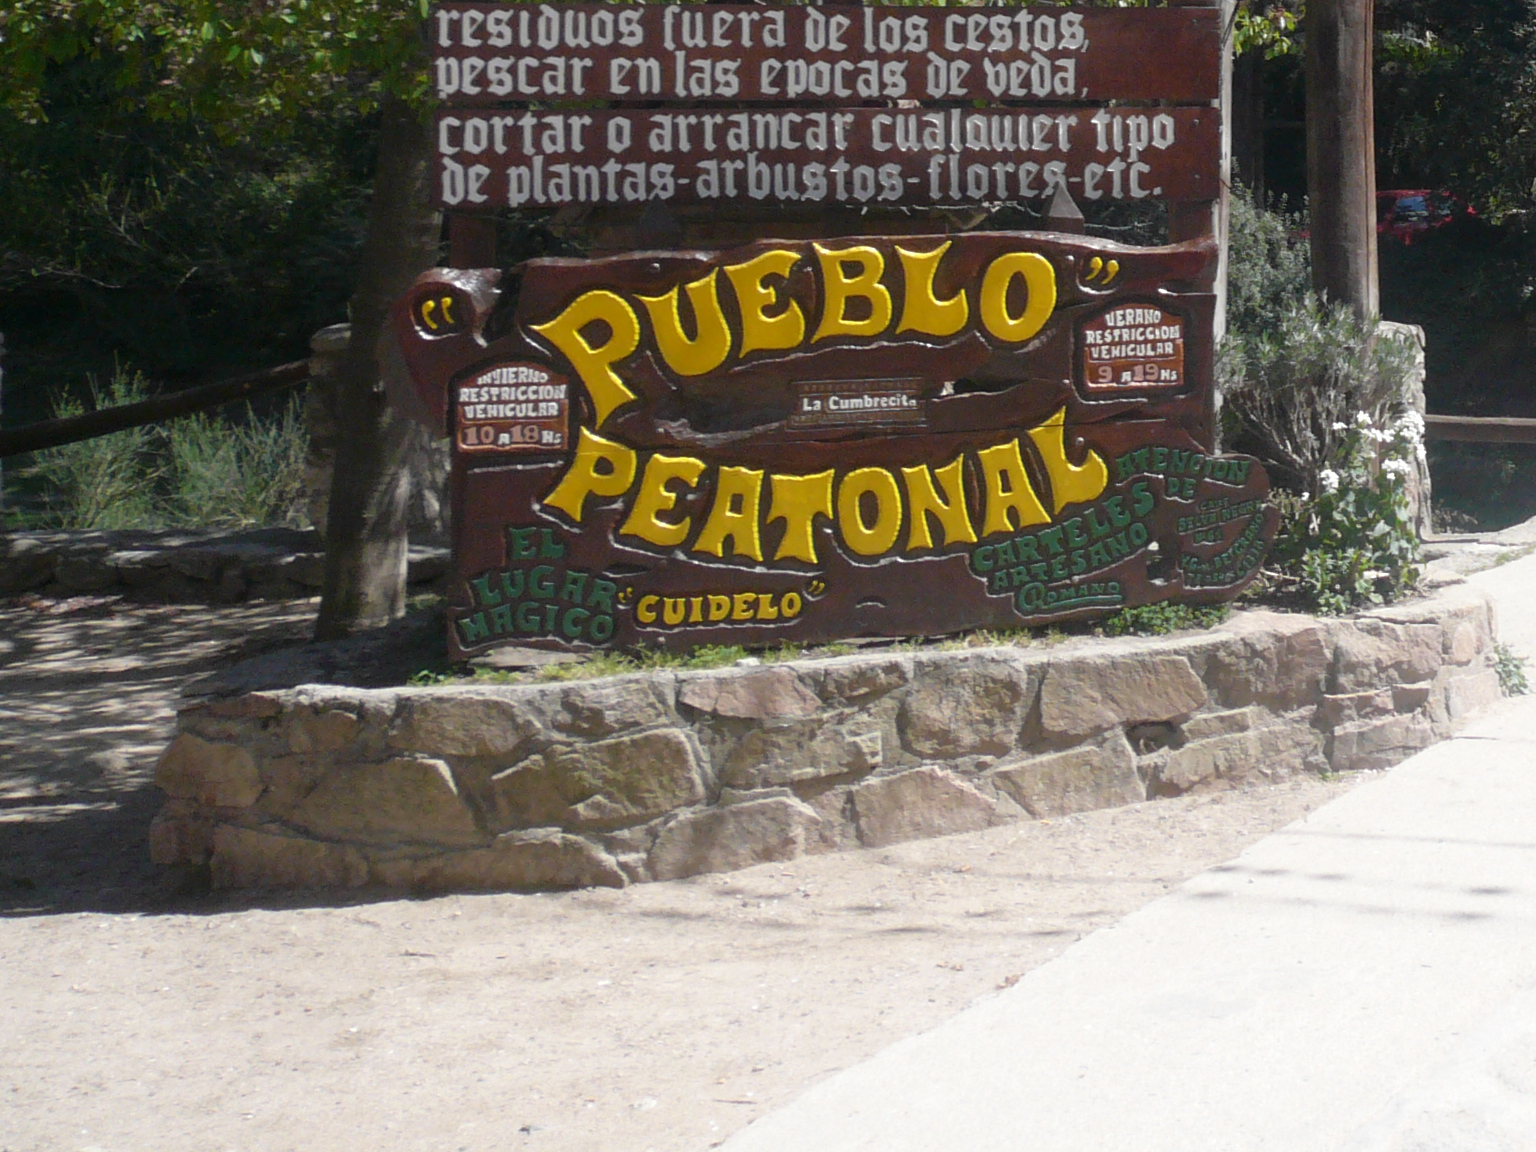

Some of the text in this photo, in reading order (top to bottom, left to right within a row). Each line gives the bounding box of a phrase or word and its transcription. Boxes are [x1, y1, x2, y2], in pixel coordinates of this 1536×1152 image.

[435, 4, 1089, 53] residuos fuera de los cestos,
[435, 55, 593, 99] pescar
[610, 57, 661, 95] en
[674, 50, 742, 97] las
[760, 57, 908, 98] epocas
[926, 51, 972, 99] de
[438, 108, 1175, 162] cortar o arrancar cualquier tipo
[440, 156, 490, 205] de
[1105, 308, 1161, 326] VERANO
[526, 241, 1058, 428] PUEBLO
[1085, 325, 1180, 344] RESTRICCION
[1090, 341, 1174, 359] VEHICULAR
[477, 366, 549, 385] INVIERNO
[1098, 365, 1113, 383] 9
[1133, 363, 1159, 381] 19
[459, 384, 567, 402] RESTRICCION
[464, 402, 559, 418] VEHICULAR
[803, 394, 917, 412] La Cumbrecita
[464, 425, 495, 445] 10
[510, 424, 539, 443] 18
[1115, 447, 1251, 483] ATENCION
[540, 406, 1108, 566] PEATONAL
[1167, 477, 1197, 497] DE
[508, 527, 564, 560] EL
[973, 482, 1155, 571] CARTELES
[993, 522, 1148, 590] ARTESANO
[472, 565, 618, 614] LUGAR
[458, 601, 614, 643] MAGICO
